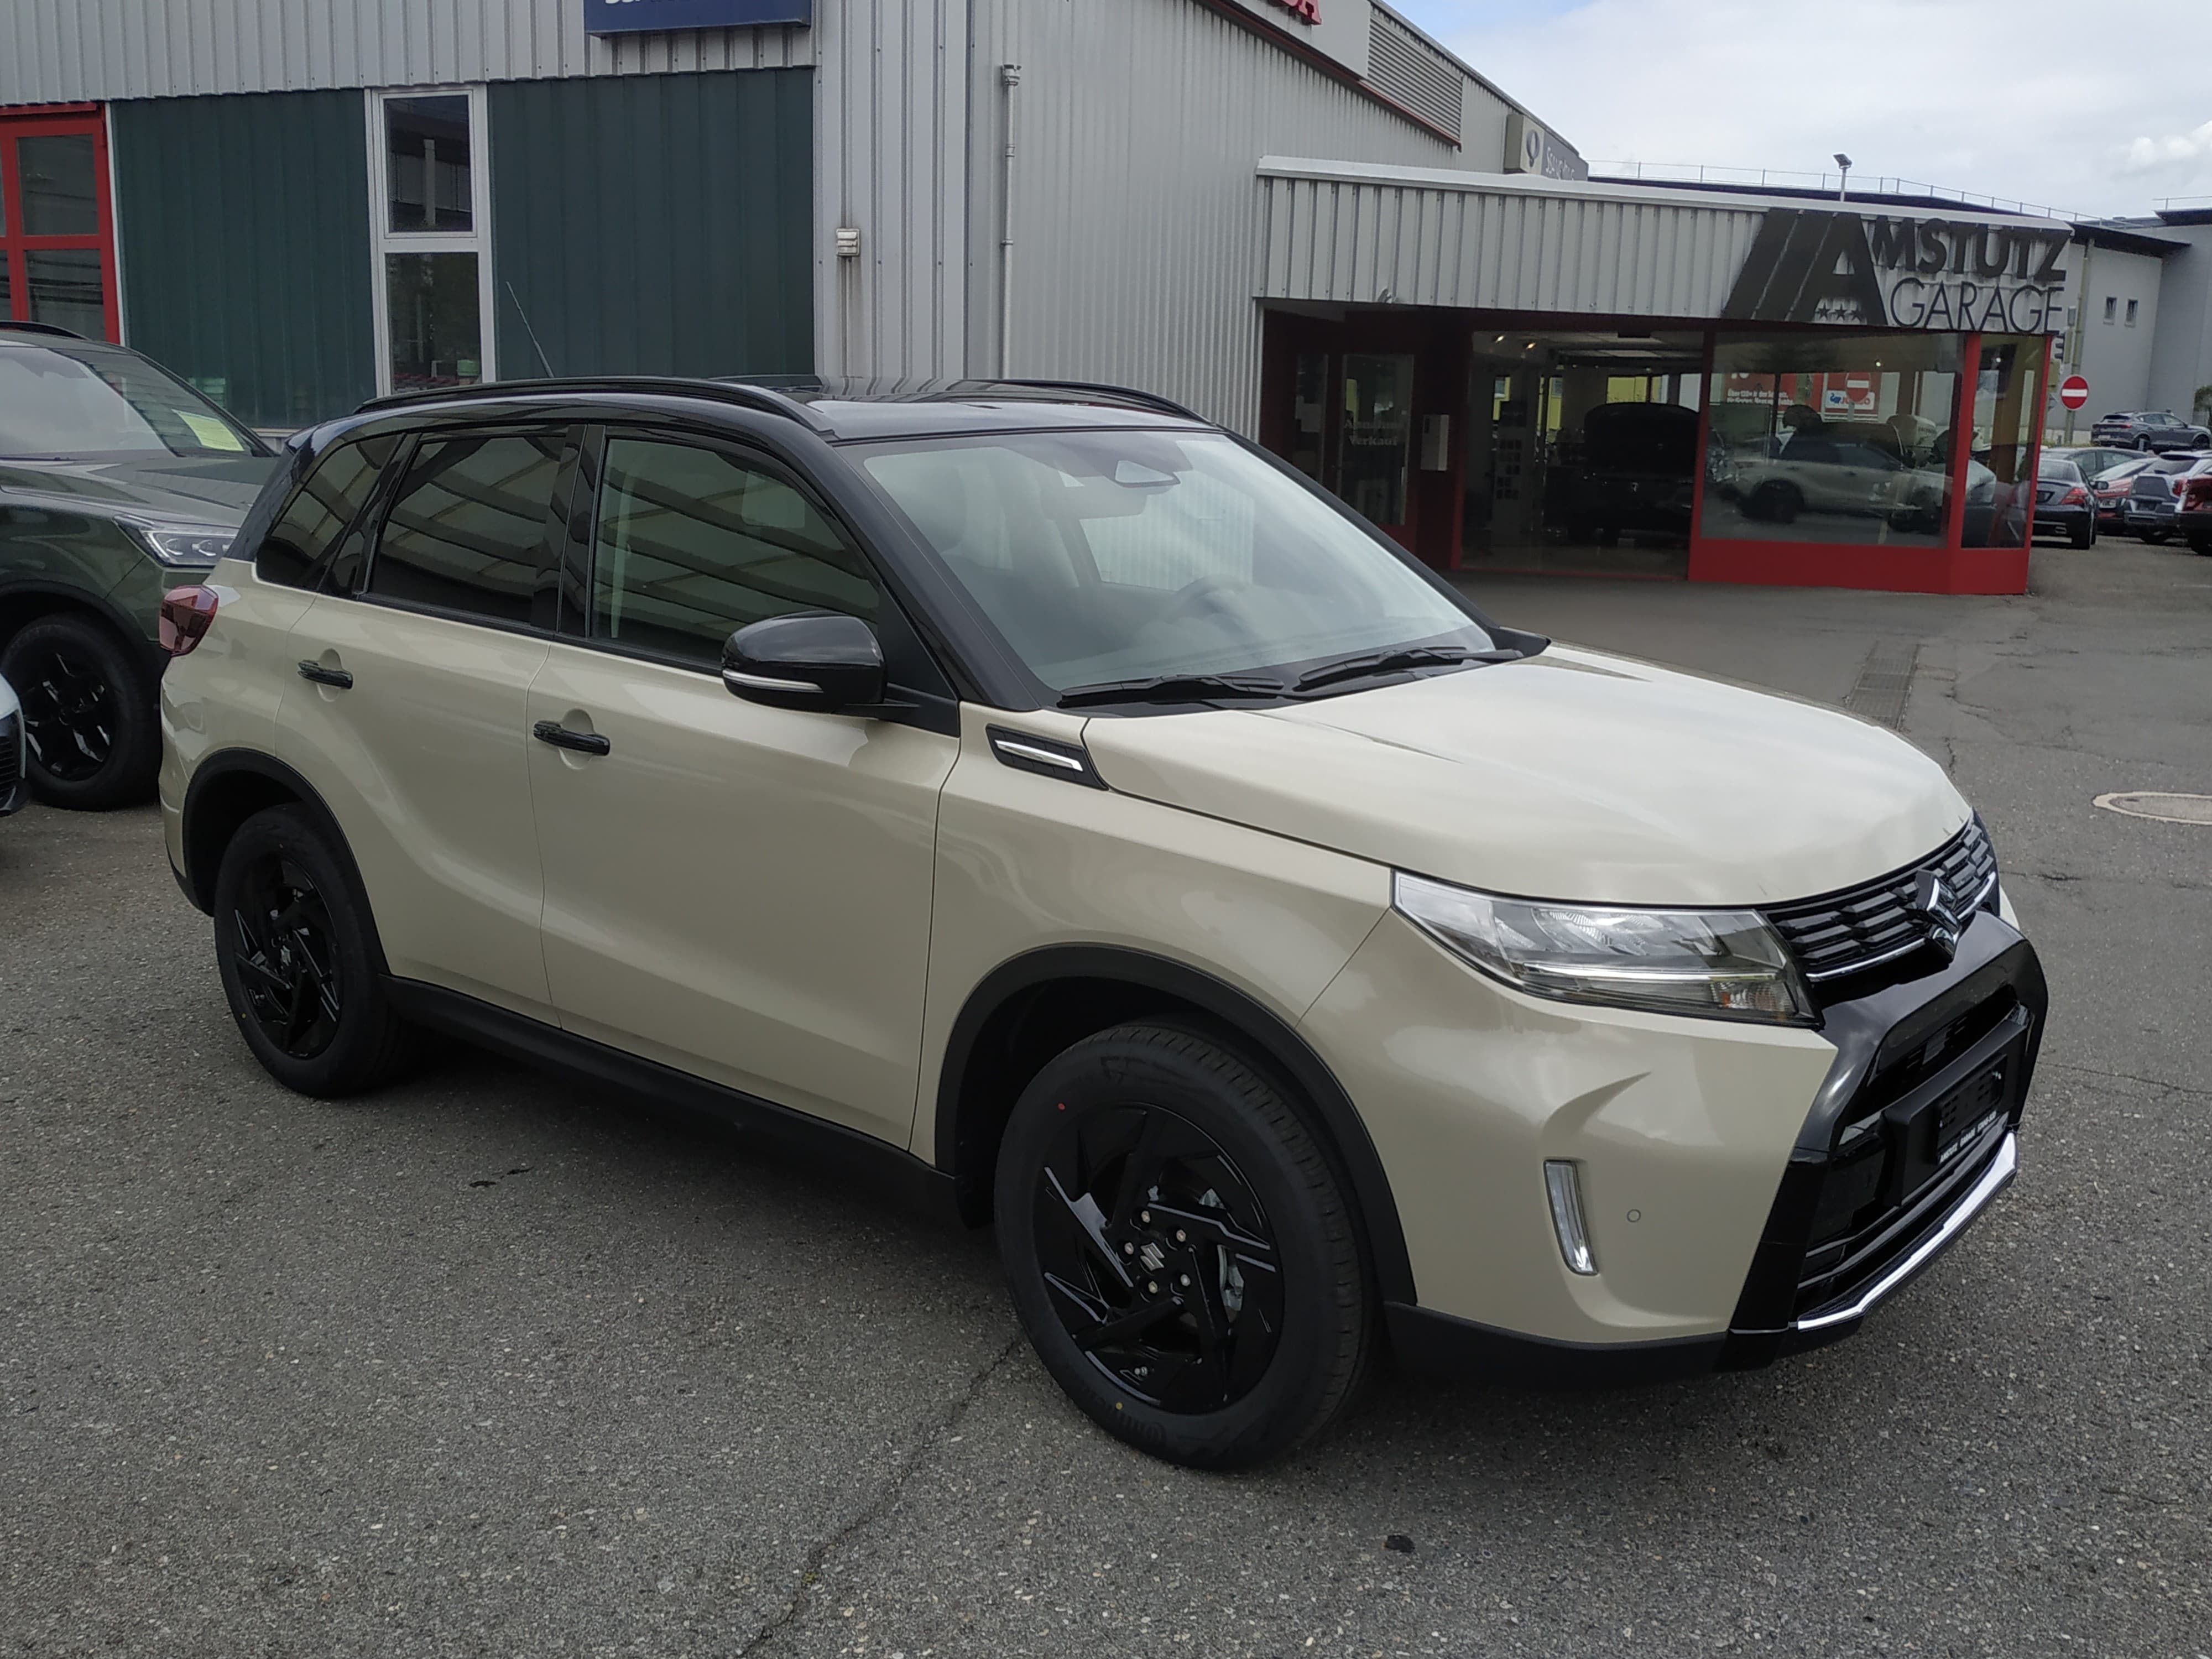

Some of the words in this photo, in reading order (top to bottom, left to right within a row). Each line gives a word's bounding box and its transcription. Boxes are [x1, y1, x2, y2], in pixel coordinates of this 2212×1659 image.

[1785, 208, 2073, 325] AMSTUTZ
[1890, 277, 2064, 335] GARAGE
[1841, 397, 1870, 405] JUO
[1349, 436, 1399, 446] Verkauf
